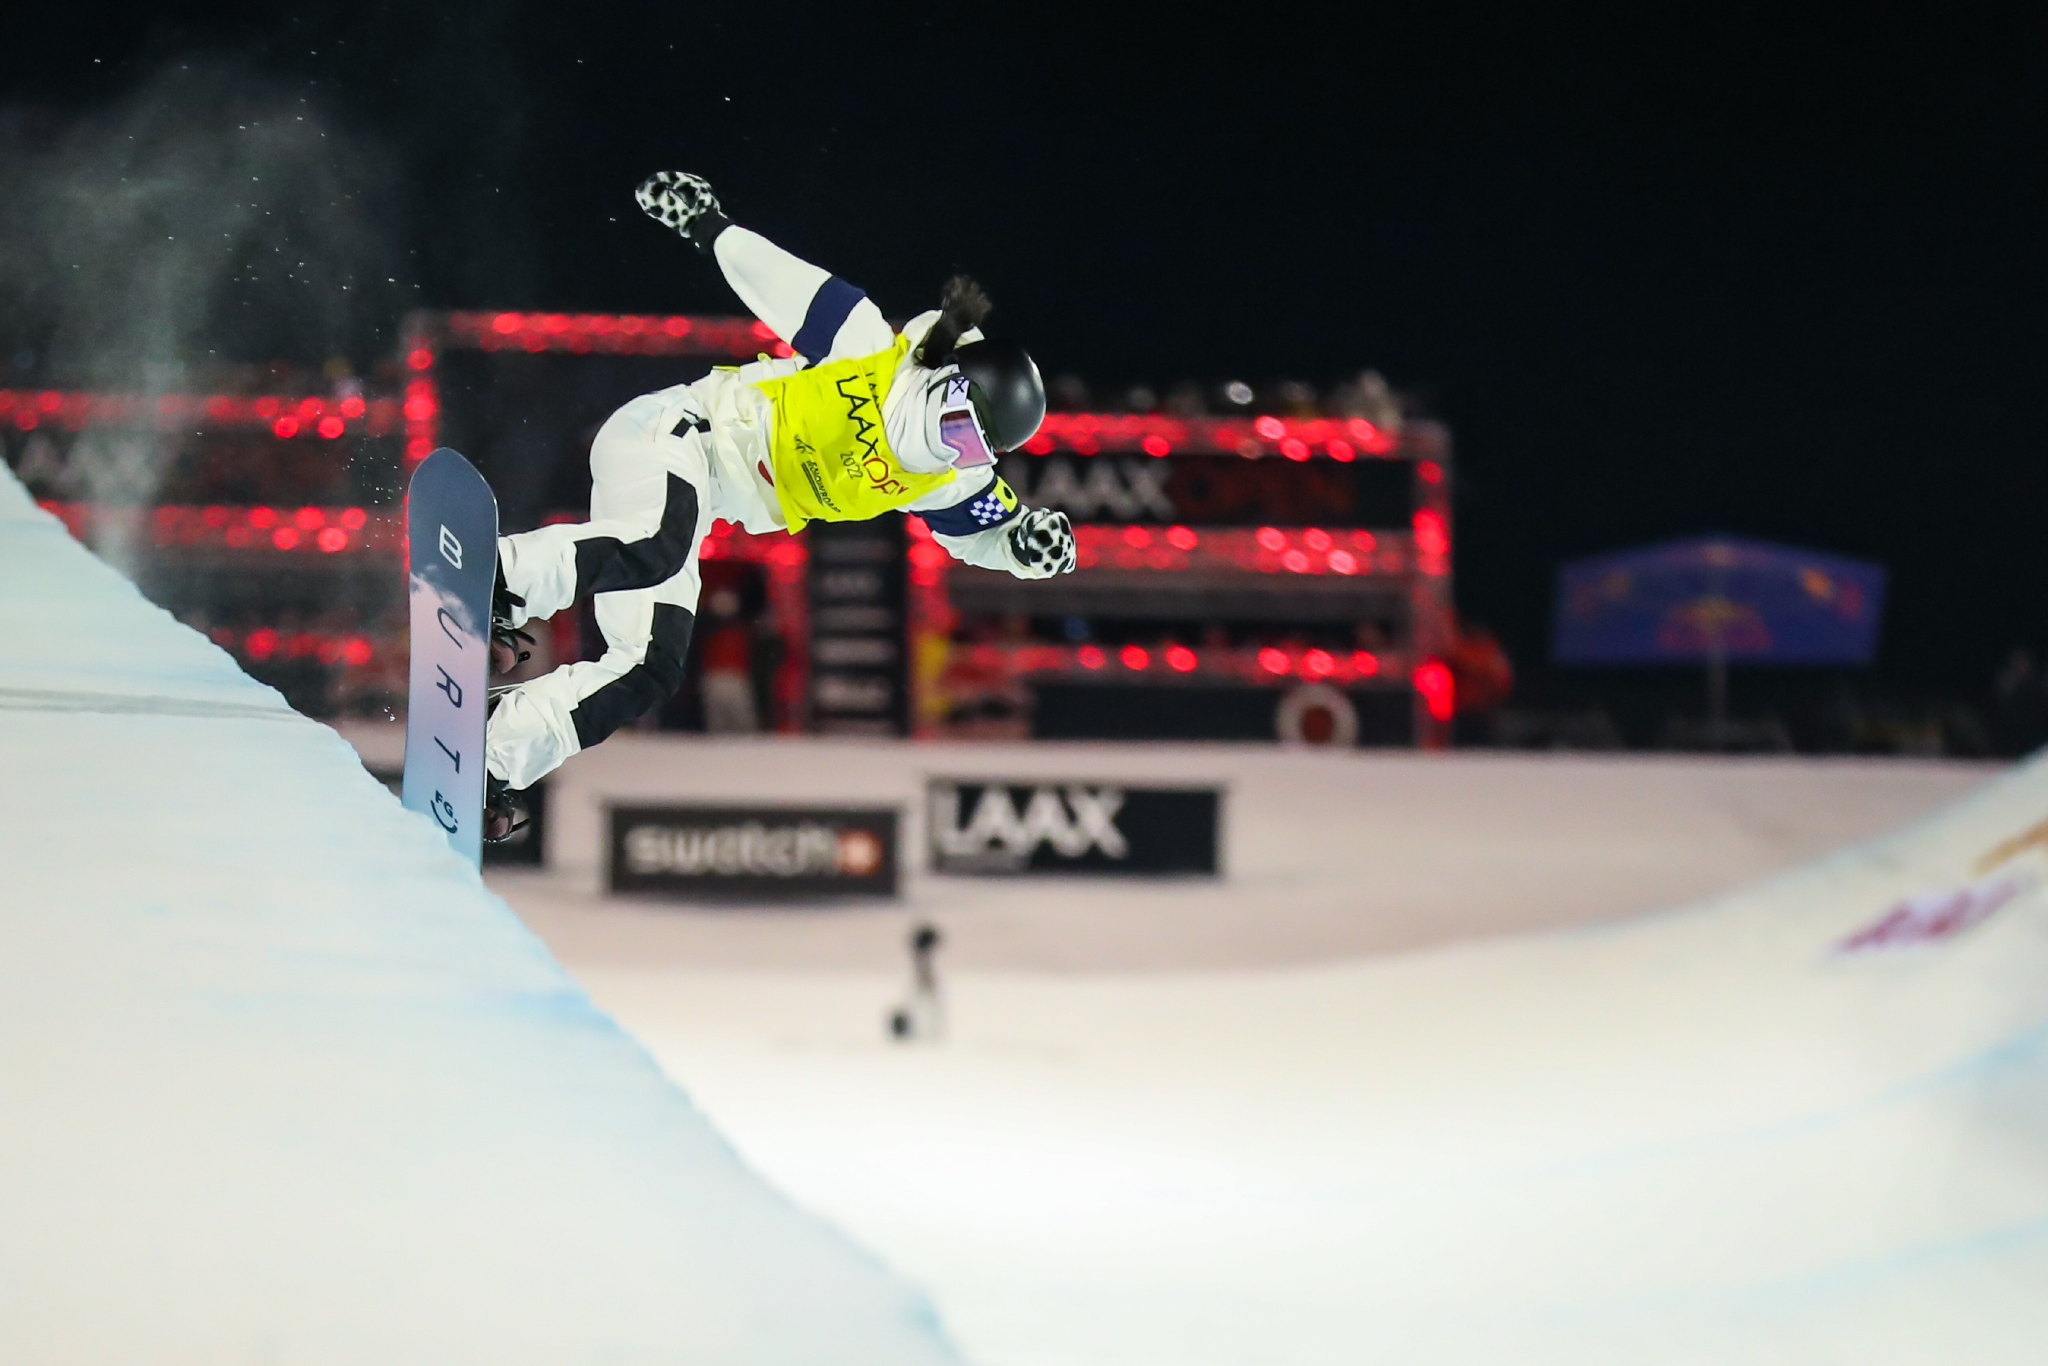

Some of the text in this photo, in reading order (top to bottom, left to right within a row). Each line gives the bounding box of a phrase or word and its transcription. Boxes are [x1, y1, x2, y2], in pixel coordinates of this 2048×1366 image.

[840, 451, 863, 480] 2022
[624, 820, 839, 877] swatch
[928, 783, 1129, 858] LAAX
